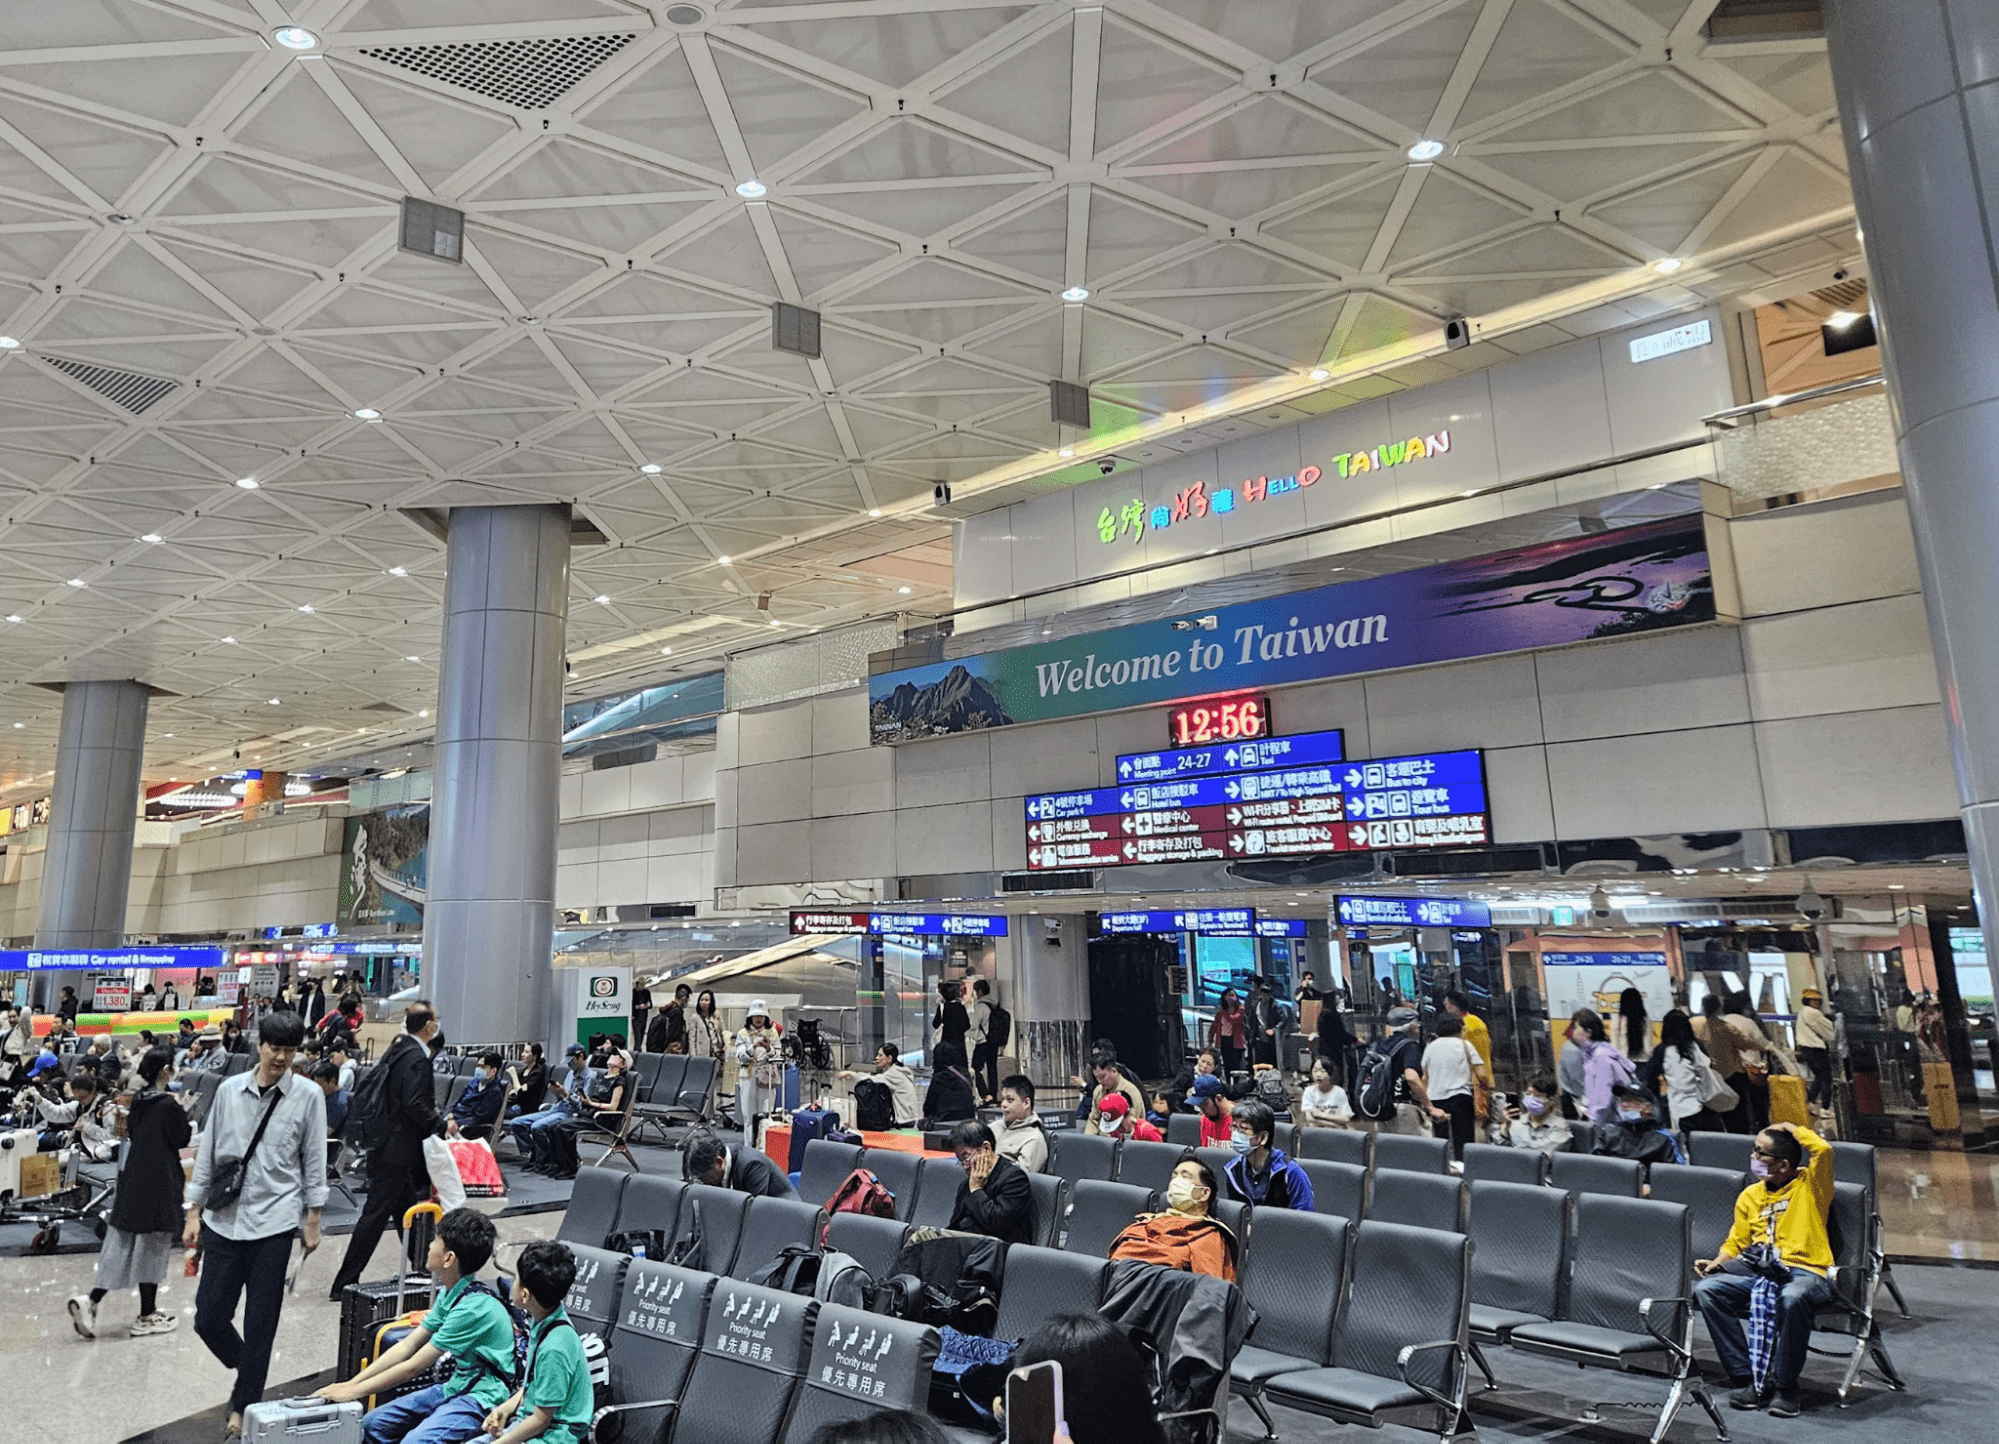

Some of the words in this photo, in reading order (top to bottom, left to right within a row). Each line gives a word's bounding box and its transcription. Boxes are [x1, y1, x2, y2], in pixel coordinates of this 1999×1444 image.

[1332, 430, 1450, 478] TAIWAN
[1035, 650, 1181, 698] Welcome
[1189, 639, 1223, 672] to
[1234, 614, 1388, 666] Taiwan
[1177, 702, 1260, 743] 12:56
[1178, 753, 1211, 770] 24-27
[1260, 757, 1274, 765] Taxi
[1134, 771, 1160, 779] Meeting
[1160, 768, 1177, 779] point
[1386, 778, 1402, 787] Bus
[1403, 777, 1411, 786] to
[1412, 776, 1428, 786] city
[1152, 800, 1168, 808] Hotel
[1169, 799, 1181, 807] bus
[1412, 805, 1431, 814] Tour
[1432, 804, 1450, 813] bus
[1056, 809, 1065, 817] Car
[1153, 824, 1178, 833] Medical
[1179, 824, 1199, 832] center
[1197, 848, 1223, 858] packing
[90, 954, 106, 965] Car
[107, 954, 131, 965] rental
[132, 954, 139, 965] &
[103, 996, 125, 1007] 1,380
[565, 1294, 592, 1312] 專用席
[638, 1298, 659, 1314] Priority
[658, 1304, 671, 1315] seat
[628, 1310, 677, 1335] 優先專用席
[729, 1321, 752, 1338] Priority
[752, 1327, 766, 1340] seat
[717, 1334, 774, 1362] 優先專用席
[835, 1352, 861, 1371] Priority
[861, 1360, 878, 1373] seat
[821, 1365, 887, 1398] 優先專用席
